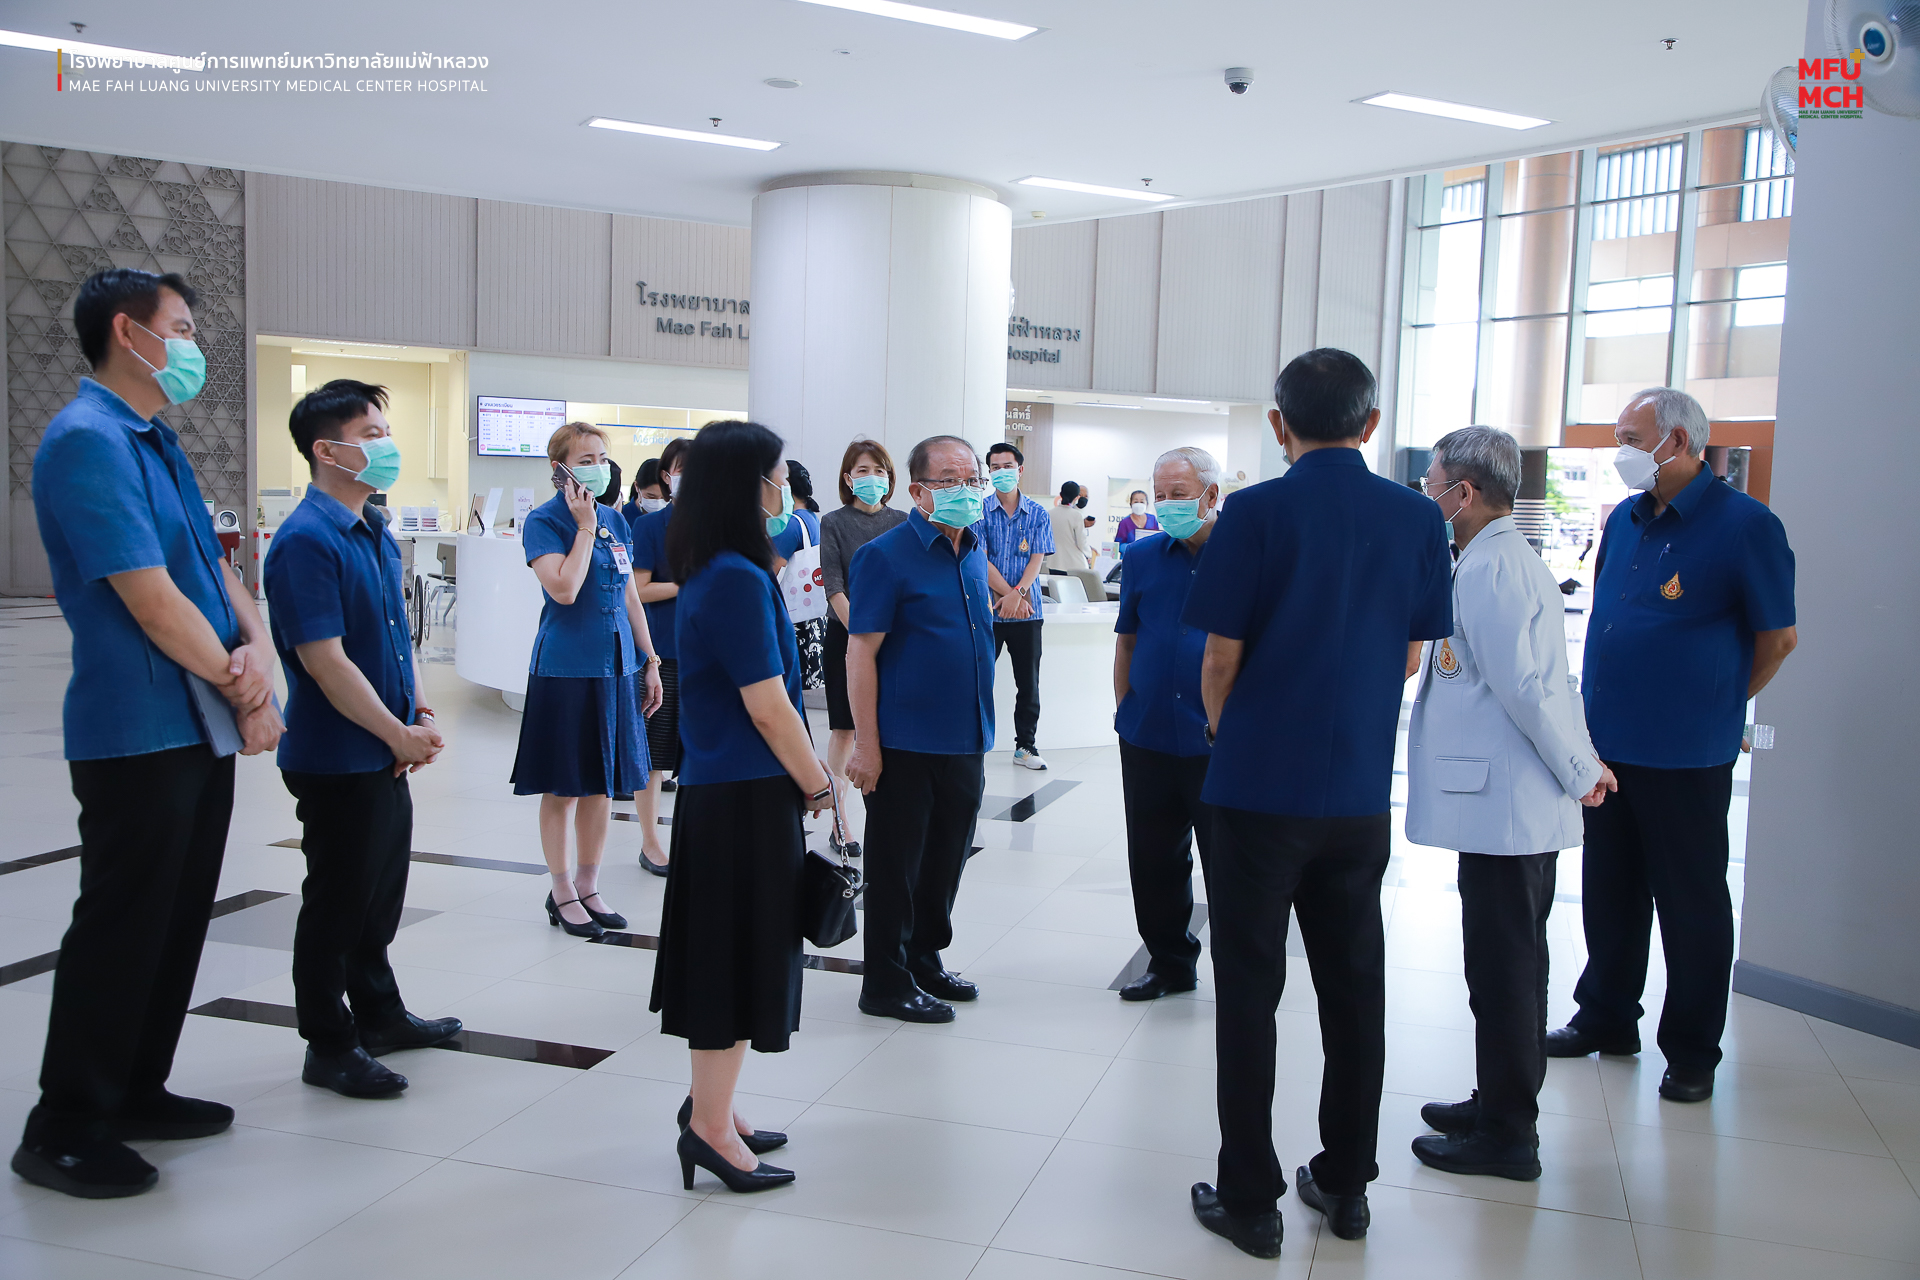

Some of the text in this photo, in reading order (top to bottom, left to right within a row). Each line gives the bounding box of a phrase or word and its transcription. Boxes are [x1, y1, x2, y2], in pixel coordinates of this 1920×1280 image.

[636, 280, 751, 315] โรงพยาบาล
[656, 317, 750, 340] Mae Fah L
[1012, 422, 1033, 432] Office
